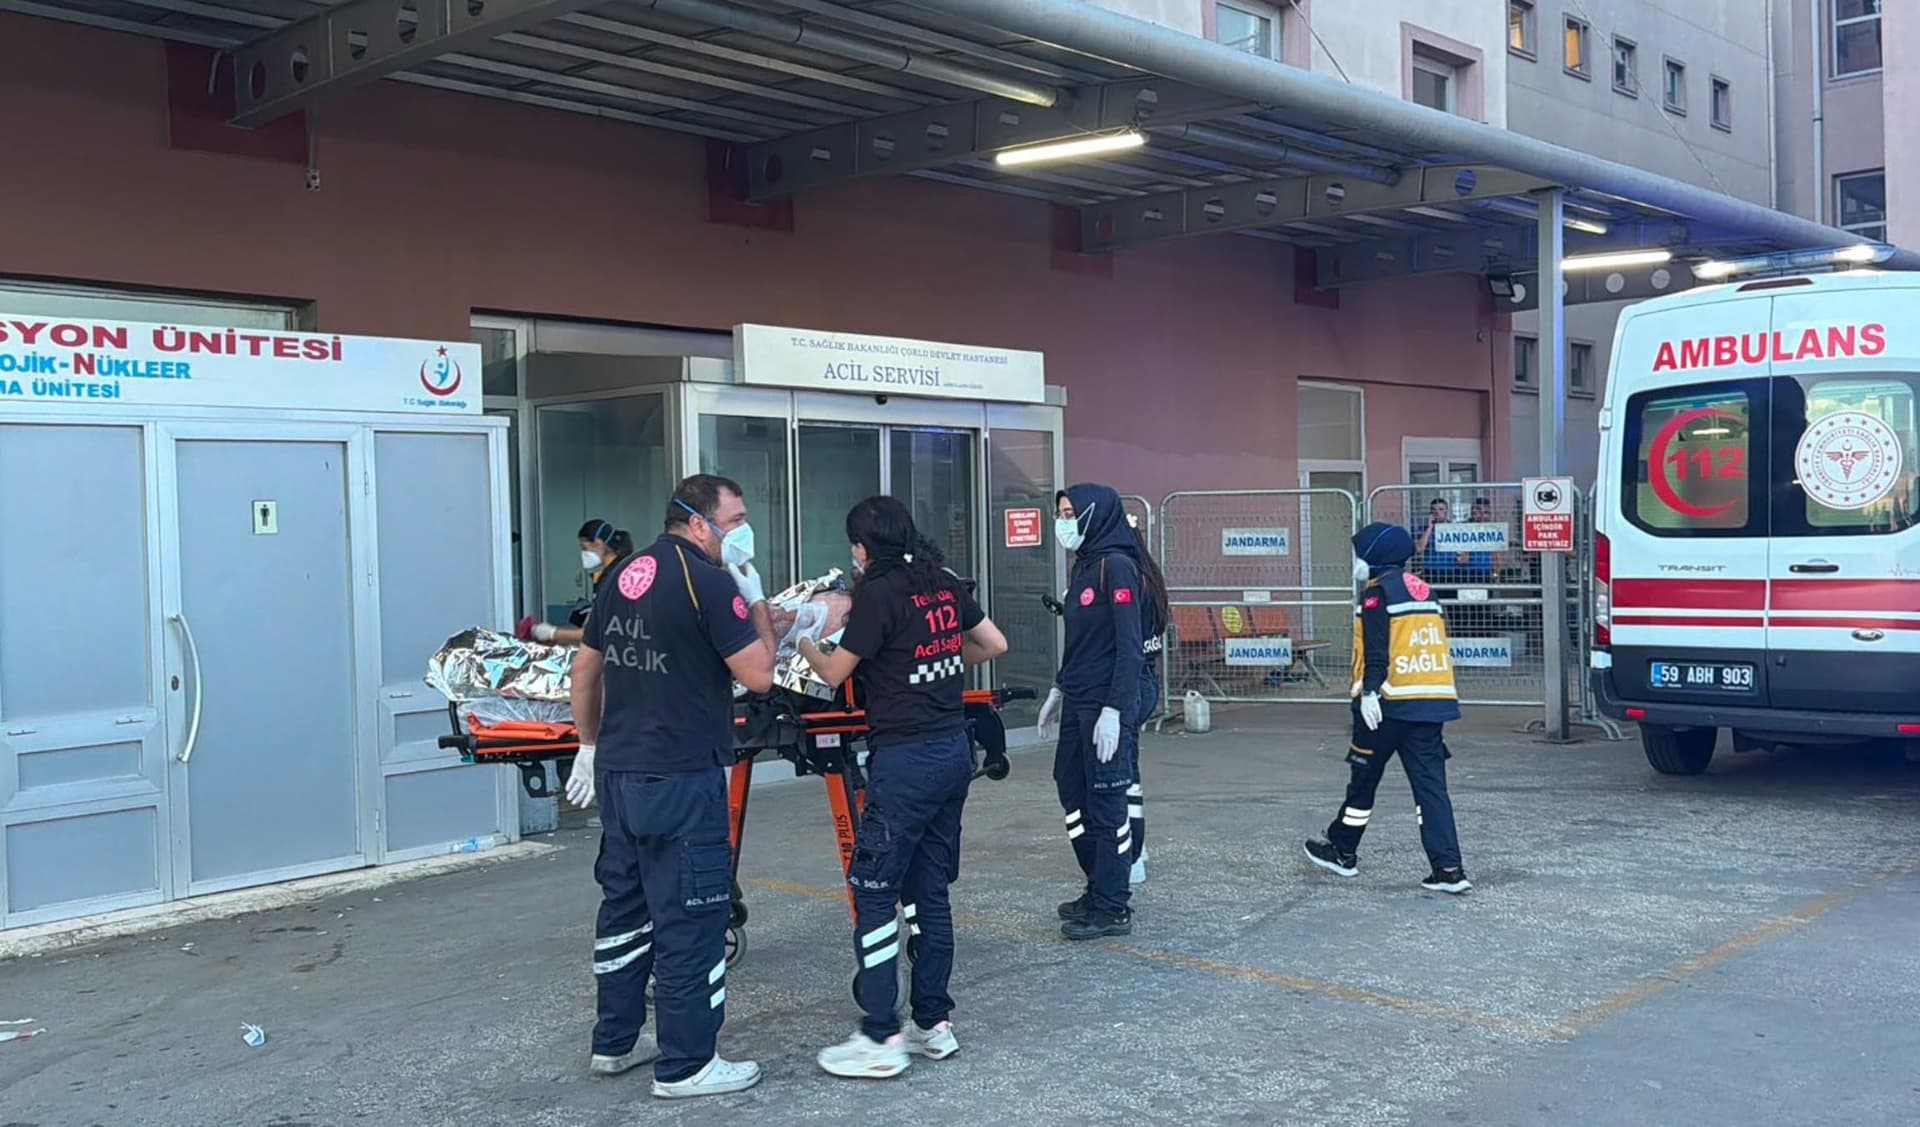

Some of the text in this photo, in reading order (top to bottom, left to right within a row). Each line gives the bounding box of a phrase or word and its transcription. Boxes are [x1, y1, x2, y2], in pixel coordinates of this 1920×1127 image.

[153, 326, 342, 361] ÜNİTESİ
[1652, 323, 1886, 372] AMBULANS
[824, 359, 940, 387] ACİL SERVİSİ
[32, 378, 120, 398] ÜNİTESİ
[1666, 446, 1746, 480] 112
[1225, 536, 1286, 547] JANDARMA
[1437, 531, 1505, 543] JANDARMA
[925, 605, 958, 633] 112
[1408, 622, 1443, 647] ACİL
[1228, 647, 1289, 658] JANDARMA
[1450, 647, 1508, 659] ANDARMA
[1661, 665, 1750, 685] 59 ABH 903
[835, 814, 849, 838] PLUS
